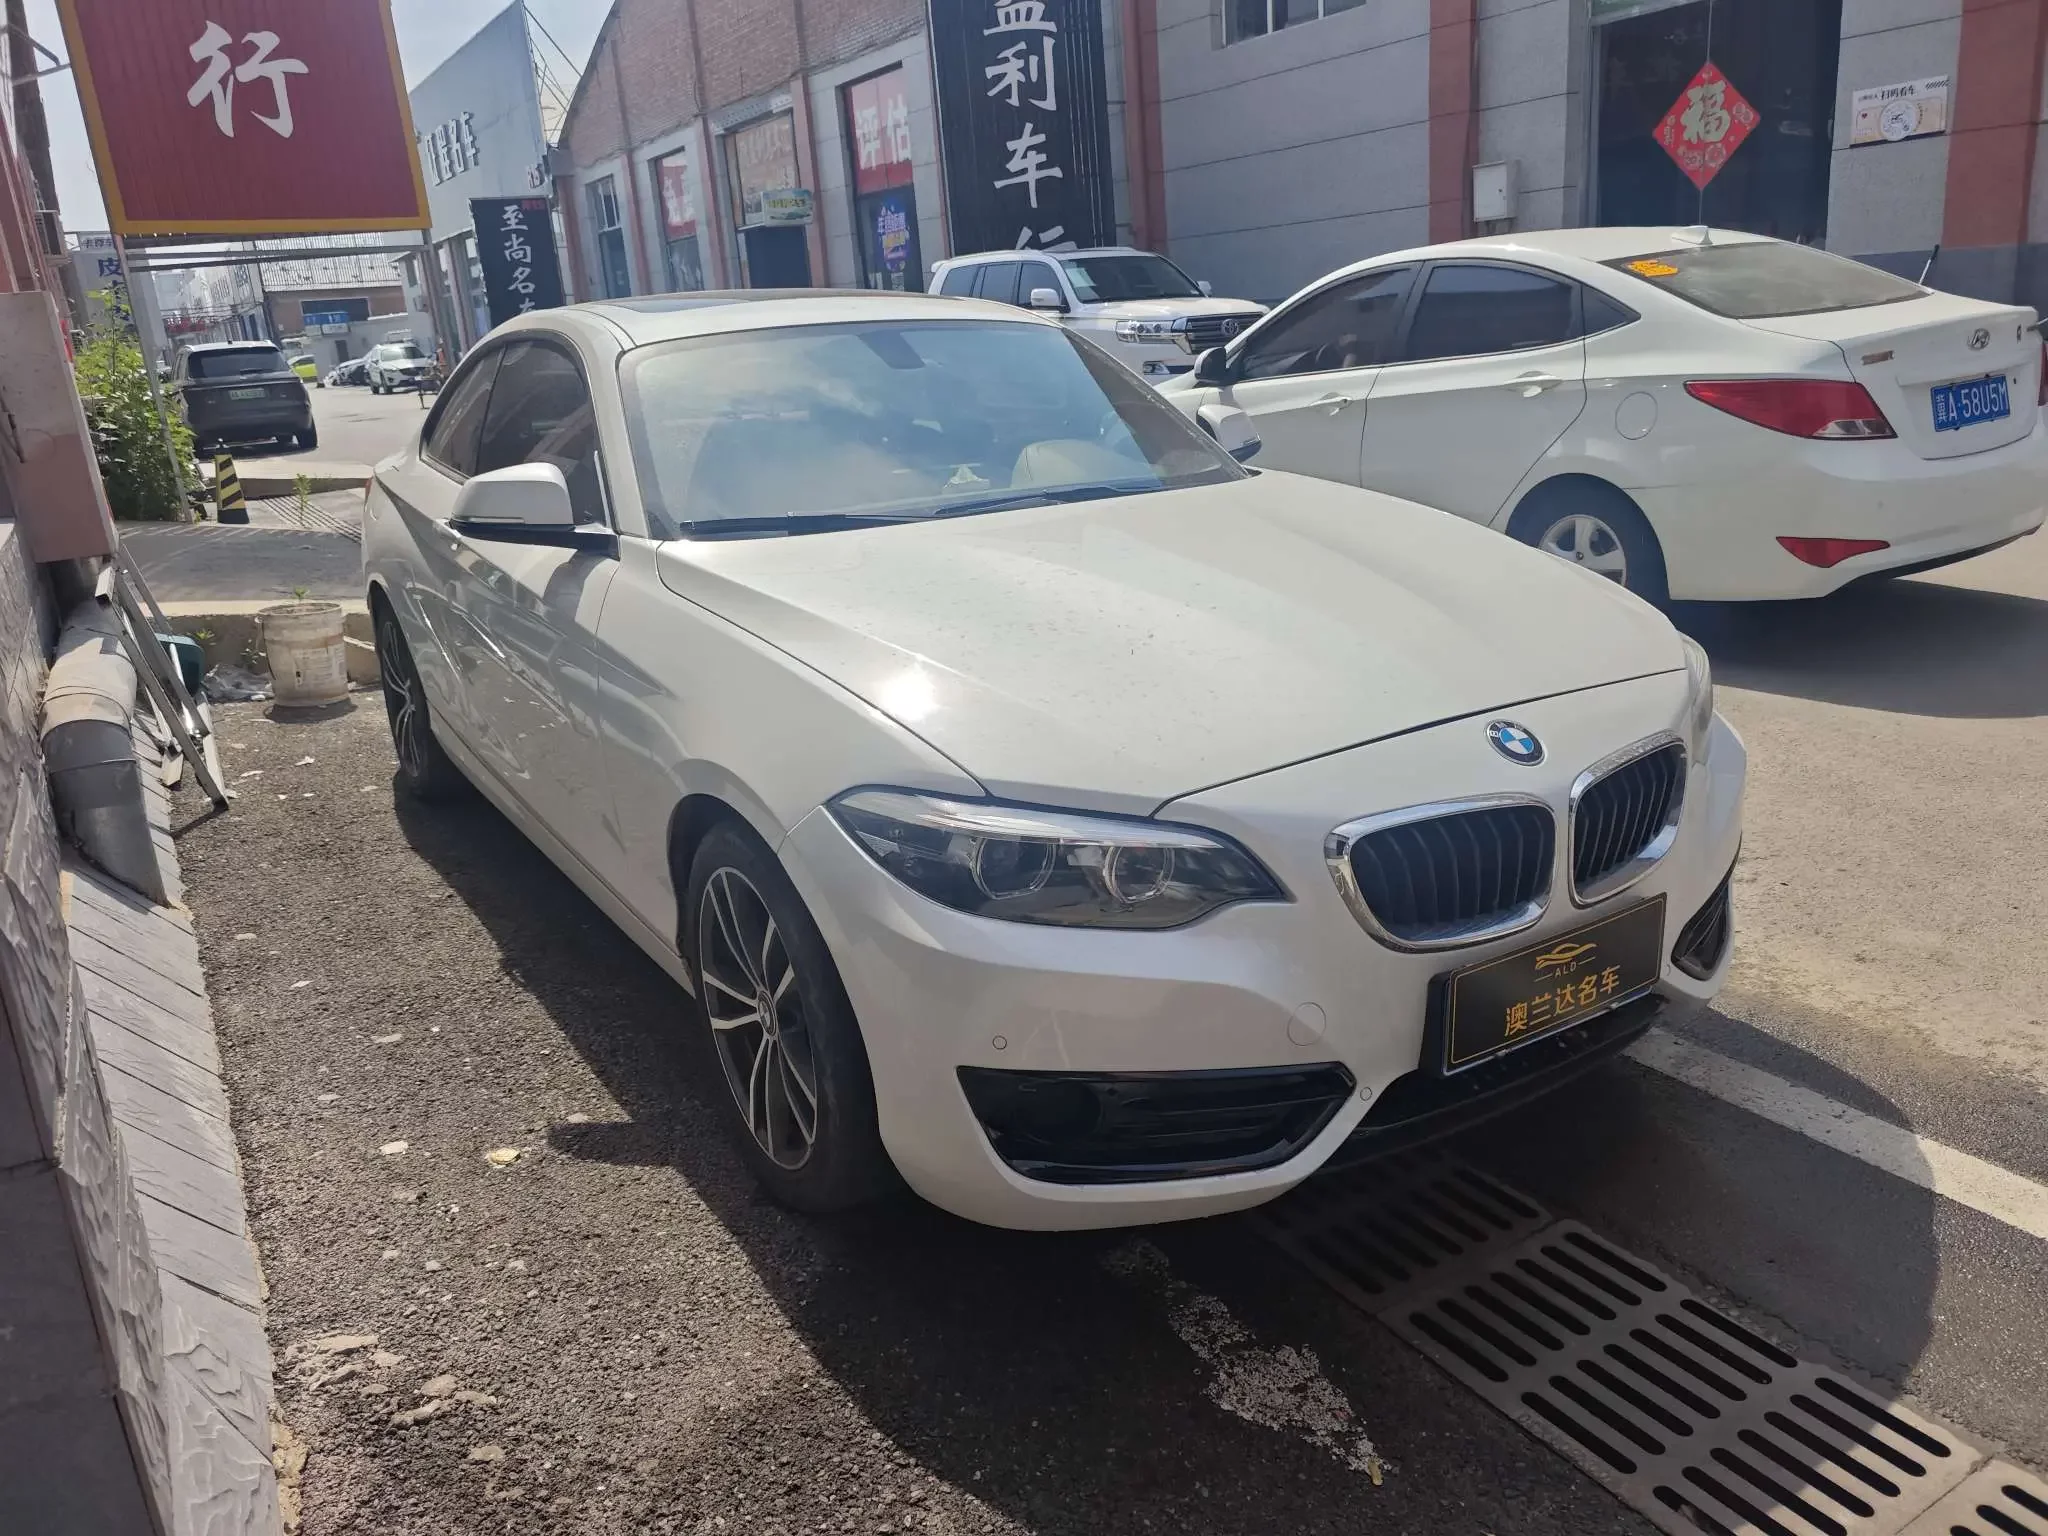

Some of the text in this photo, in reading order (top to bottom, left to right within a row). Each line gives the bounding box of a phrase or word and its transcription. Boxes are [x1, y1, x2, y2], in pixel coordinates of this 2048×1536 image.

[187, 20, 309, 138] 行
[1679, 79, 1731, 145] 福
[1503, 964, 1621, 1037] 澳兰达名车
